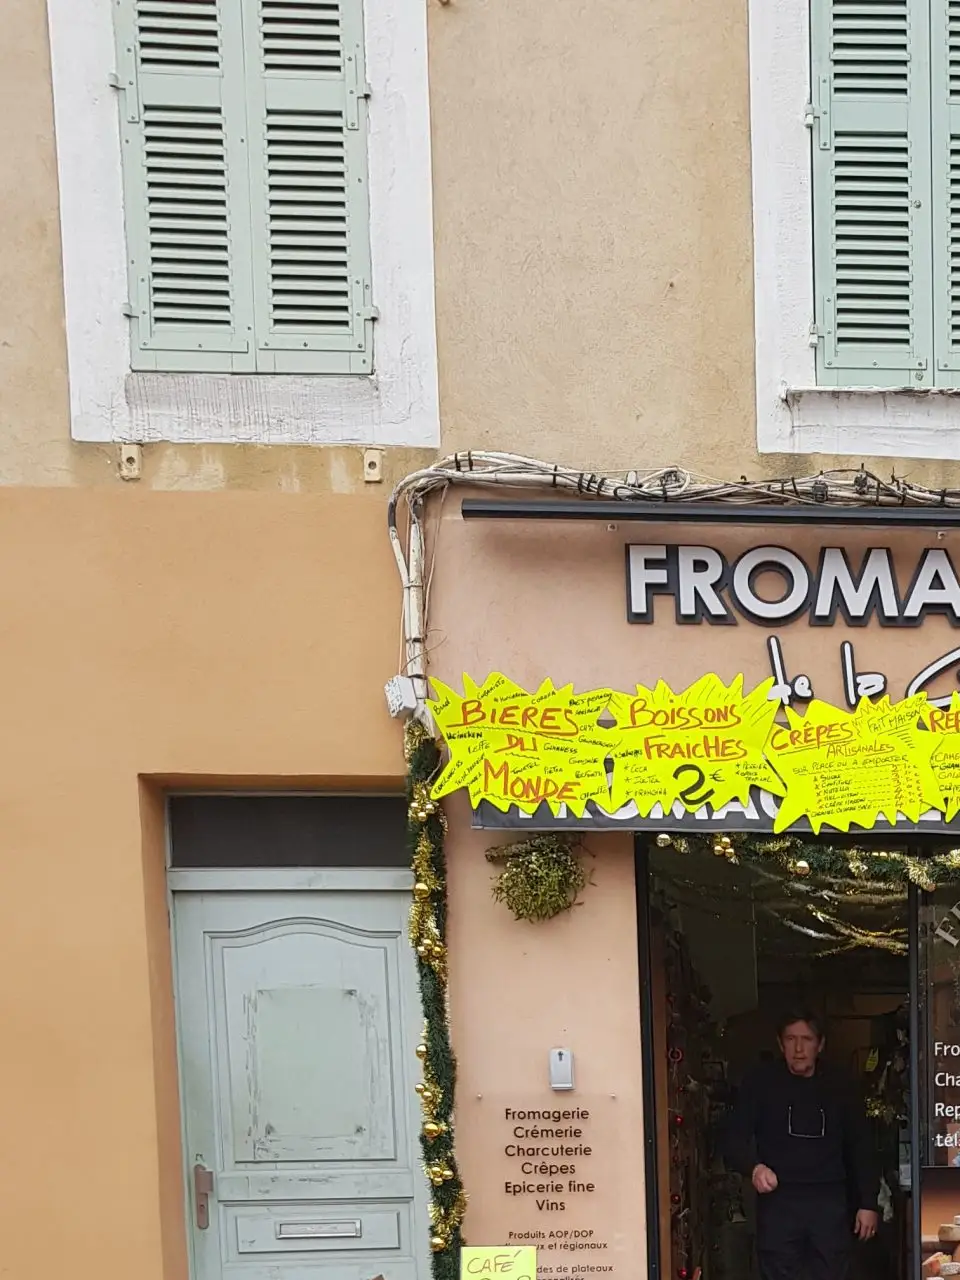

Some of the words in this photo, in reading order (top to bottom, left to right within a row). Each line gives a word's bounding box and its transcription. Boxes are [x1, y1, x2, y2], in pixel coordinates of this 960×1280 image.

[767, 636, 812, 705] de
[841, 641, 886, 706] la
[447, 699, 579, 737] BIERES
[619, 699, 742, 730] BOISSONS
[494, 734, 538, 753] DU
[770, 721, 854, 751] CRÊPES
[484, 758, 581, 803] MONDE
[673, 764, 715, 806] 2
[709, 769, 726, 783] €
[505, 1107, 590, 1122] Fromagerie
[513, 1124, 583, 1138] Crémerie
[504, 1144, 592, 1157] Charcuterie
[521, 1161, 576, 1176] Crêpes
[504, 1180, 564, 1195] Epicerie
[568, 1180, 595, 1193] fine
[535, 1199, 566, 1211] Vins
[508, 1229, 546, 1240] Produits
[548, 1229, 594, 1240] AOP/DOP
[547, 1240, 557, 1250] et
[559, 1241, 608, 1252] régionaux
[466, 1250, 522, 1274] CAFÉ
[556, 1264, 569, 1273] de
[571, 1264, 613, 1274] plateaux
